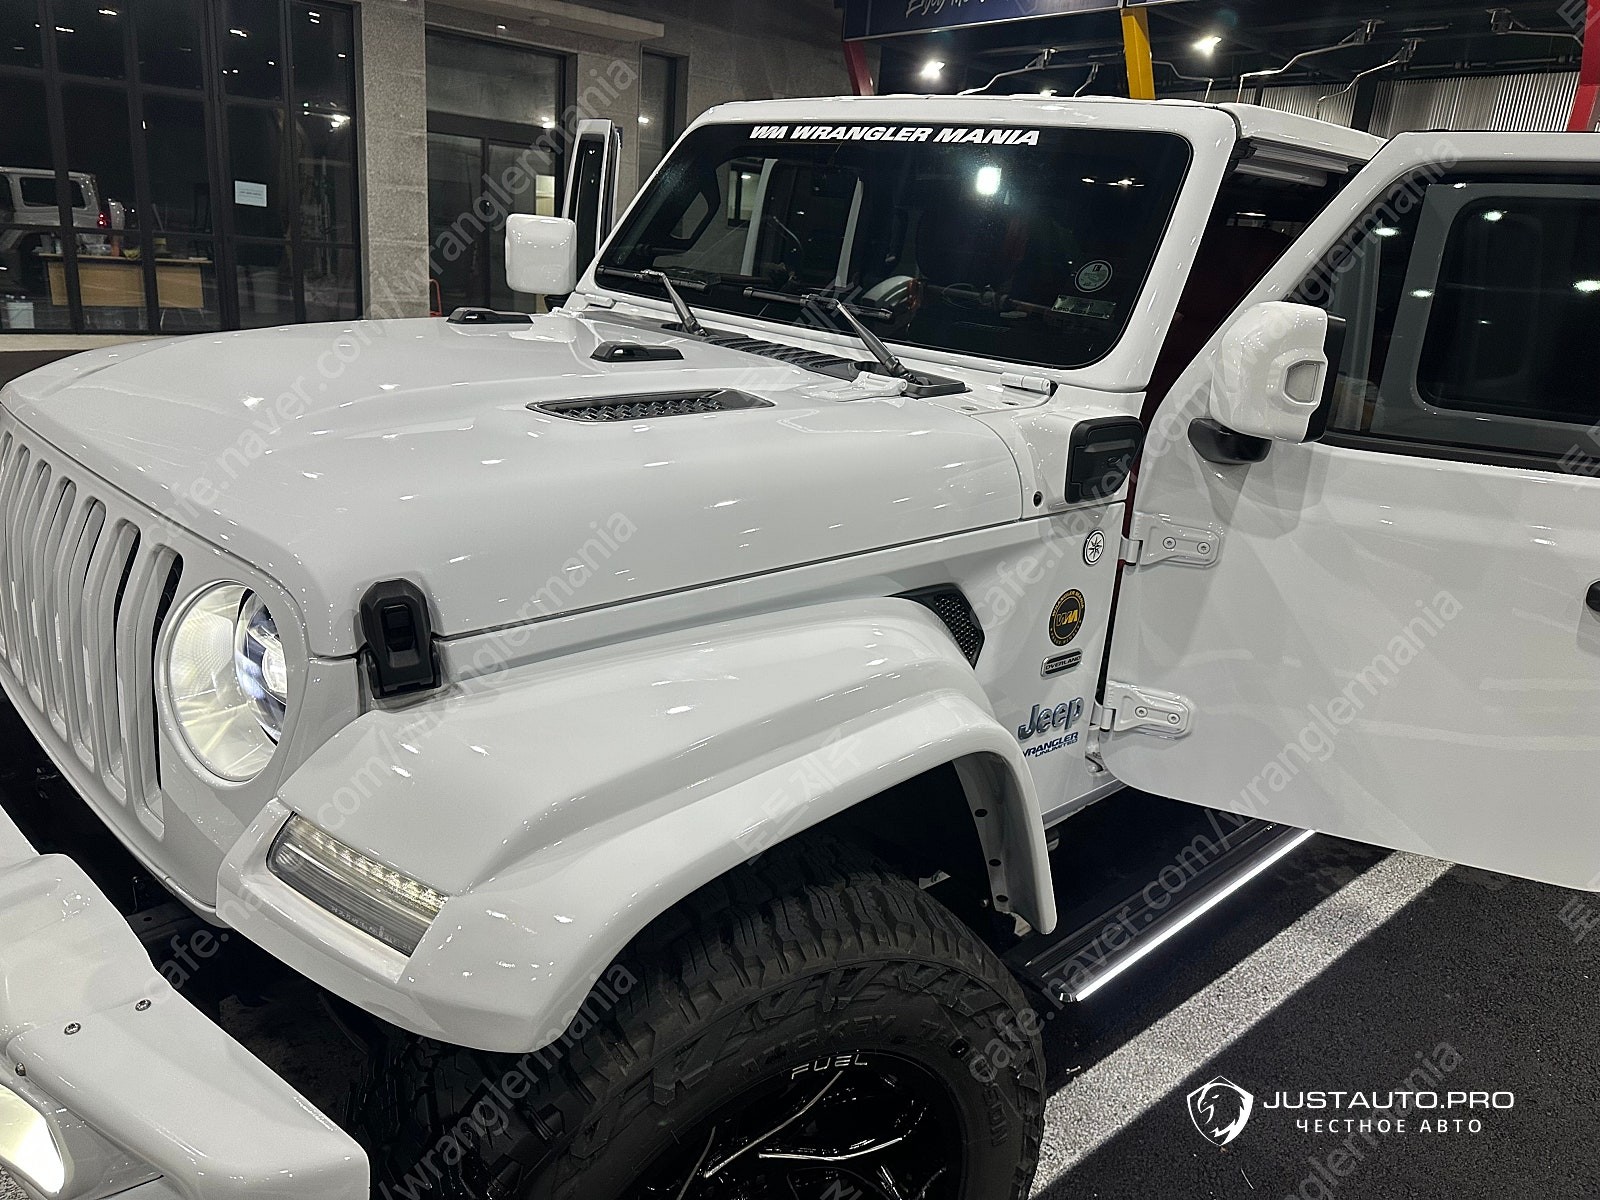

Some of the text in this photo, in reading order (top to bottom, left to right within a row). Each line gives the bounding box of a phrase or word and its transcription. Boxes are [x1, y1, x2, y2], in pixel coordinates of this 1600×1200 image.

[790, 125, 930, 142] WRANGLER
[932, 128, 1040, 147] MANIA
[1018, 697, 1084, 740] Jeep
[1035, 739, 1078, 757] UNLIMITED
[791, 1054, 868, 1080] FUEL
